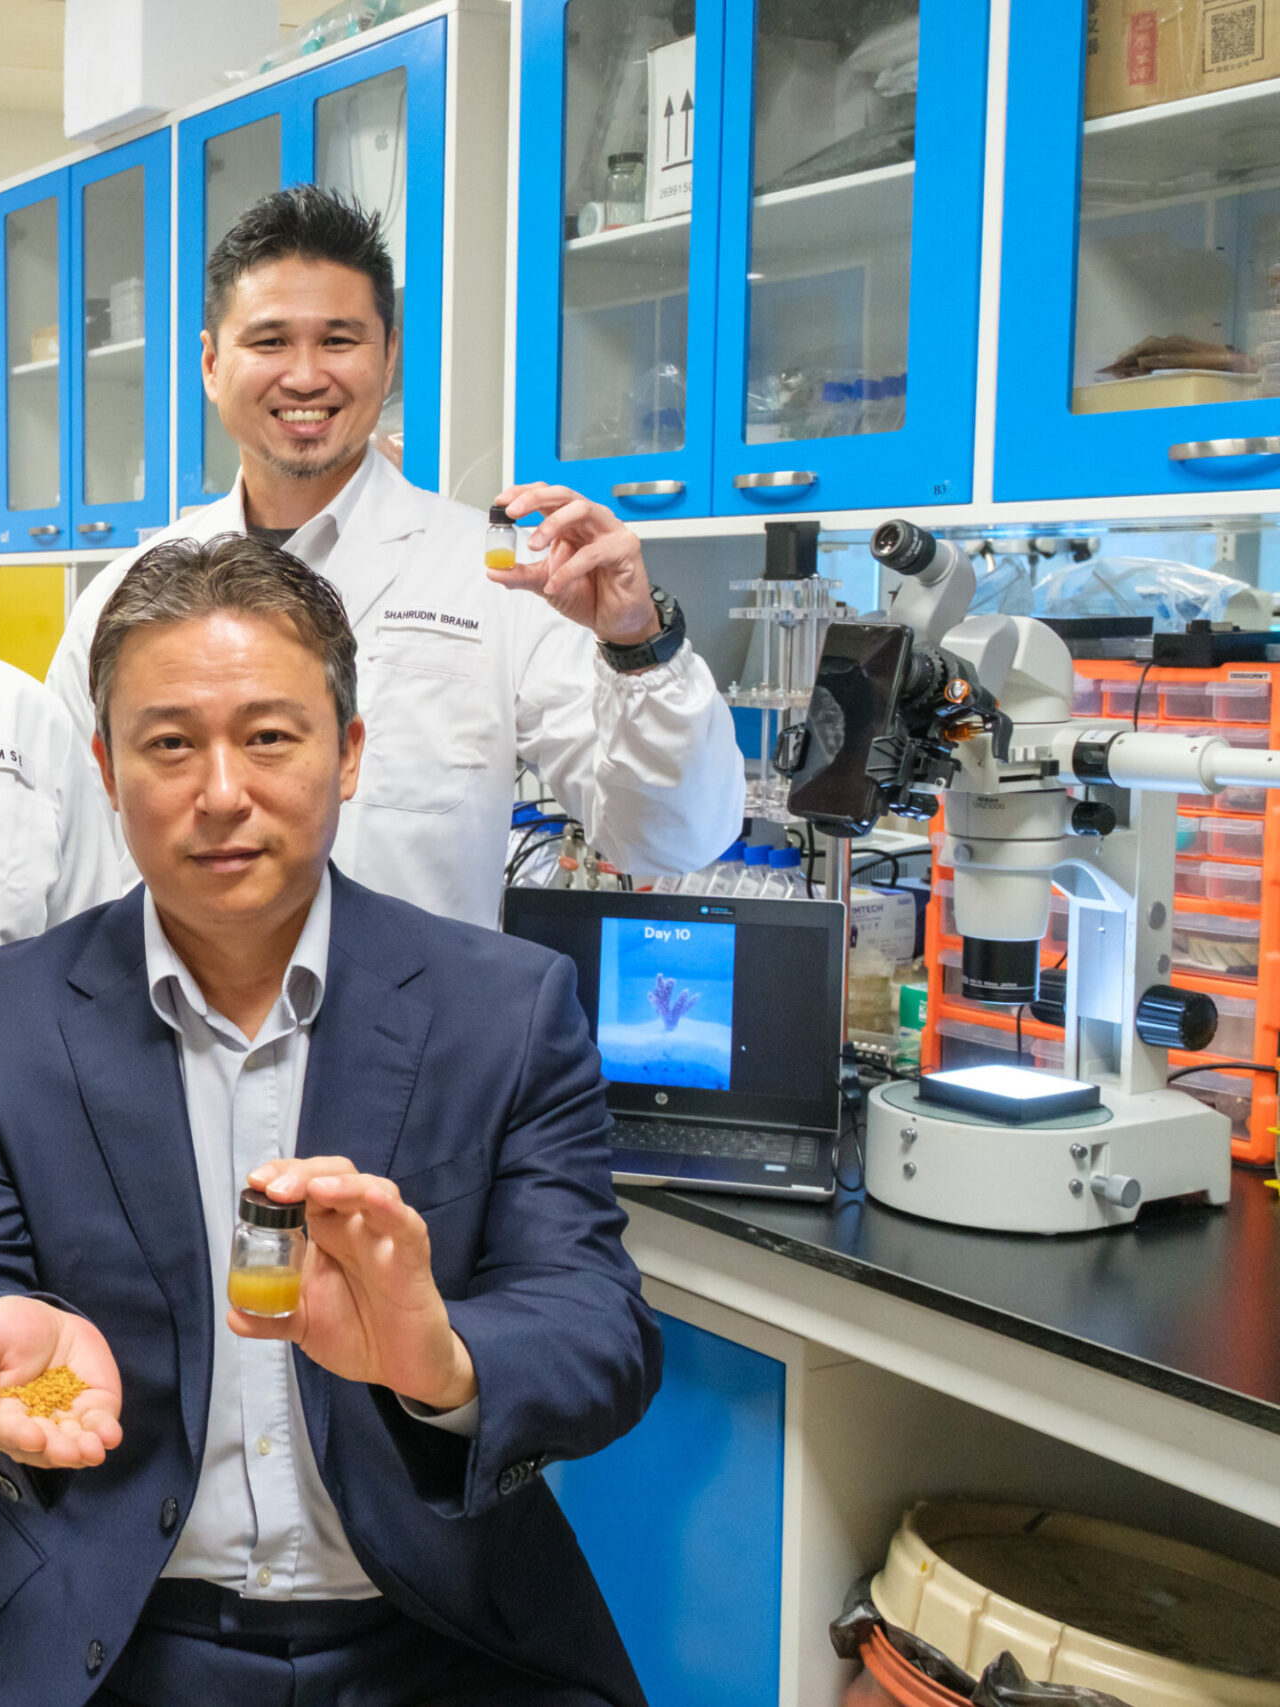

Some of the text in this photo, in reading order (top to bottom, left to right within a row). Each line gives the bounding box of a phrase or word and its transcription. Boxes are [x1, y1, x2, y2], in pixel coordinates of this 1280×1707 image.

[384, 610, 479, 629] SHAHRUDIN IBRAHIM
[851, 904, 884, 915] IMTECH
[644, 926, 690, 942] Day 10
